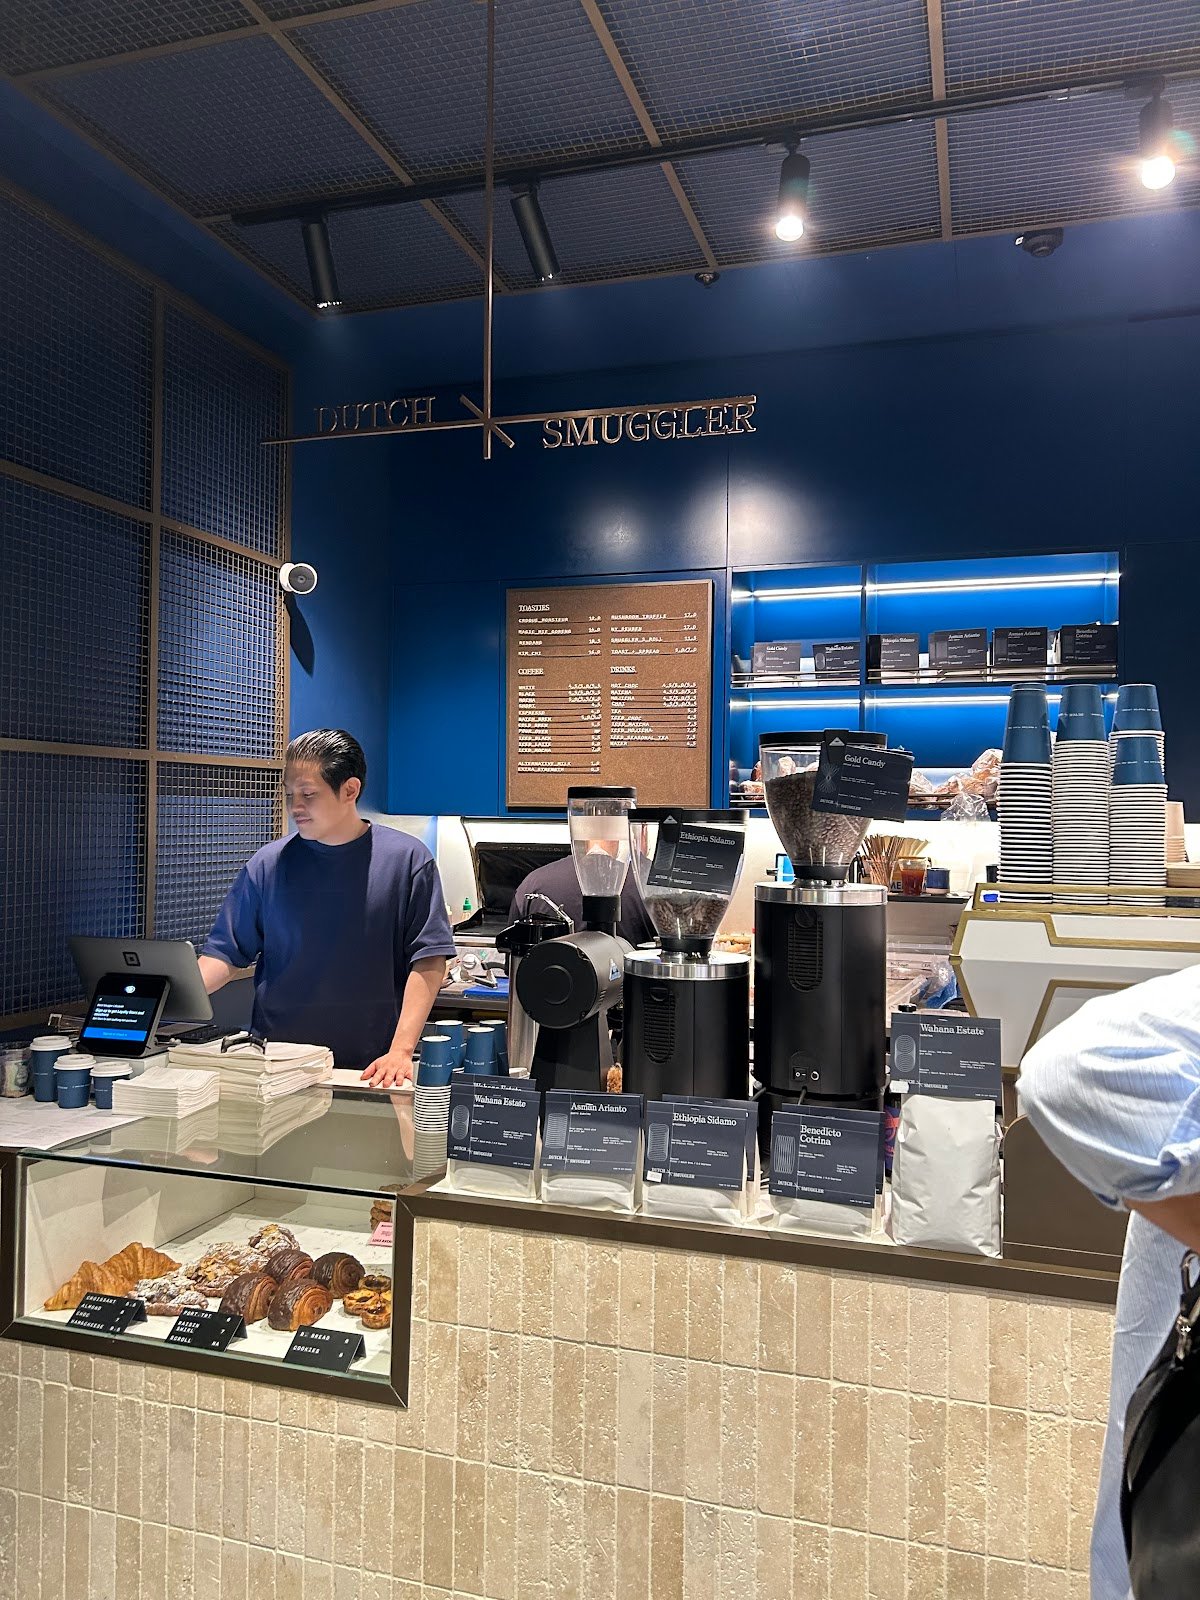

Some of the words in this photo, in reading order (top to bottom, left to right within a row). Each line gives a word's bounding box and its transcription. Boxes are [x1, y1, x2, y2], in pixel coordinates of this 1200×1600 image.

[313, 396, 436, 432] DUTCH
[542, 402, 757, 449] SMUGGLER
[844, 754, 862, 764] Gold
[862, 757, 886, 769] Candy
[680, 832, 708, 842] Ethiopia
[709, 836, 735, 845] Sidamo
[920, 1023, 955, 1034] Wahana
[956, 1025, 984, 1035] Estate
[474, 1095, 502, 1105] Wahana
[503, 1098, 526, 1108] Estate
[571, 1103, 597, 1111] Asman
[598, 1104, 627, 1113] Arianto
[673, 1112, 706, 1124] Ethiopia
[707, 1116, 737, 1126] Sidamo
[800, 1124, 841, 1138] Benedicto
[800, 1134, 831, 1146] Cotrina
[86, 1295, 117, 1304] CROISSANT
[170, 1335, 192, 1343] SCROLL
[293, 1345, 320, 1354] COOKIES
